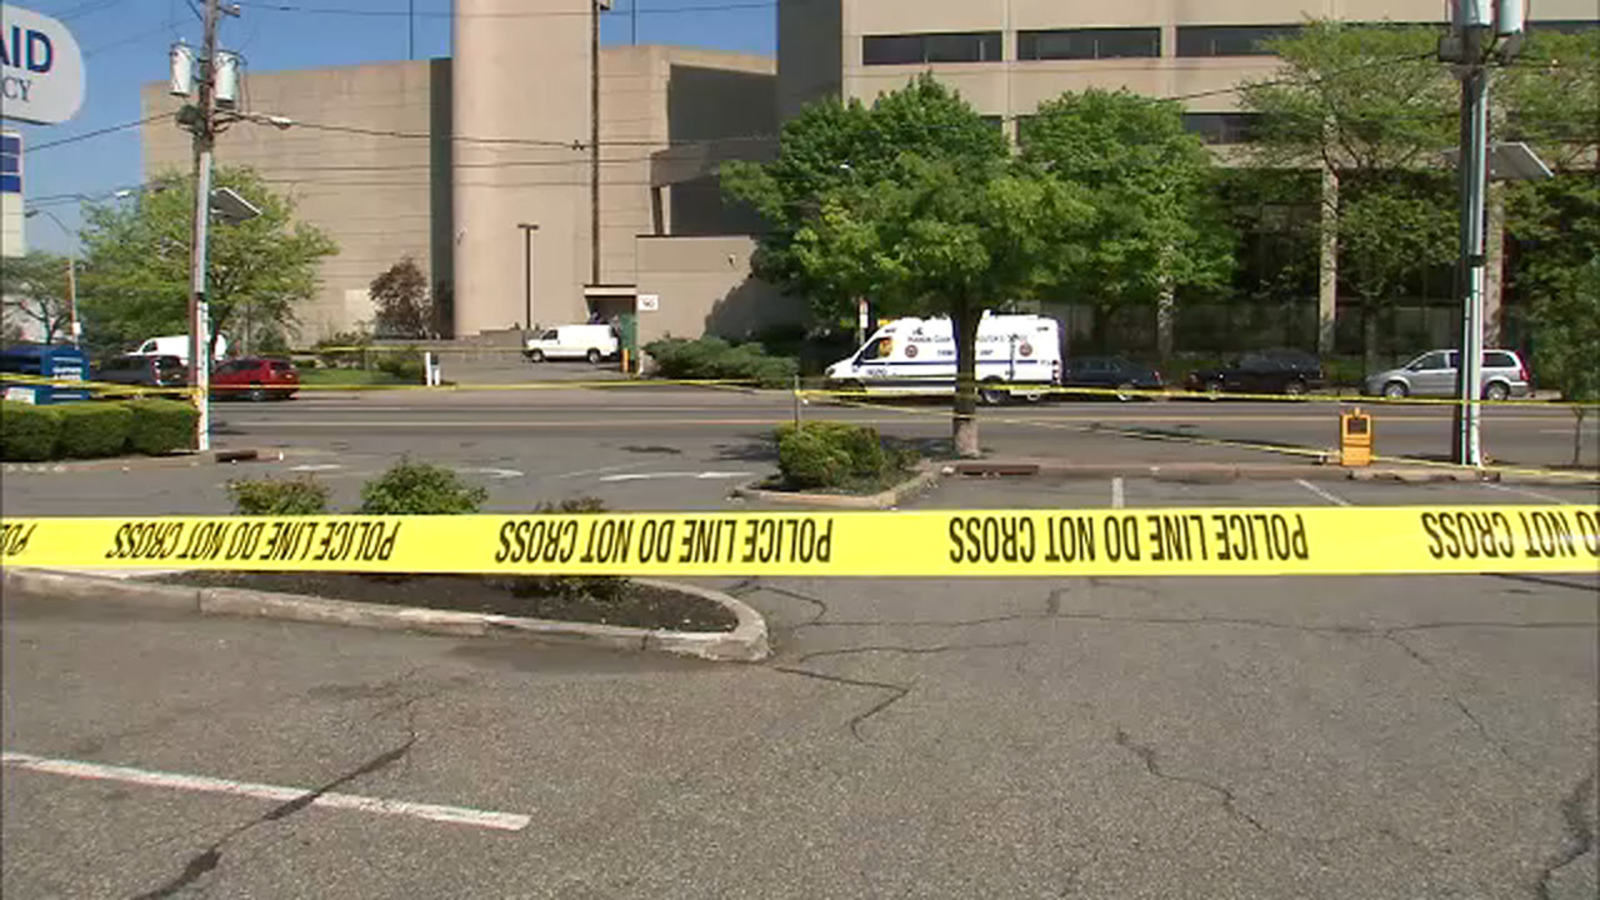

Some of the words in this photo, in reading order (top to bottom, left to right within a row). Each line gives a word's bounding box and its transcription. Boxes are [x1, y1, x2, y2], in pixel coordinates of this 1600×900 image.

[104, 522, 185, 560] CROSS
[176, 521, 232, 561] NOT
[224, 521, 267, 561] DO
[259, 521, 320, 561] LINE
[312, 521, 402, 562] POLICE
[494, 519, 579, 564] CROSS
[579, 519, 635, 564] NOT
[638, 519, 676, 564] DO
[678, 519, 738, 564] LINE
[741, 517, 833, 564] POLICE
[948, 516, 1036, 564] CROSS
[1044, 516, 1096, 563] NOT
[1103, 515, 1141, 563] DO
[1146, 514, 1208, 562] LINE
[1211, 513, 1309, 561] POLICE
[1420, 511, 1515, 560] CROSS
[1518, 511, 1577, 558] NOT
